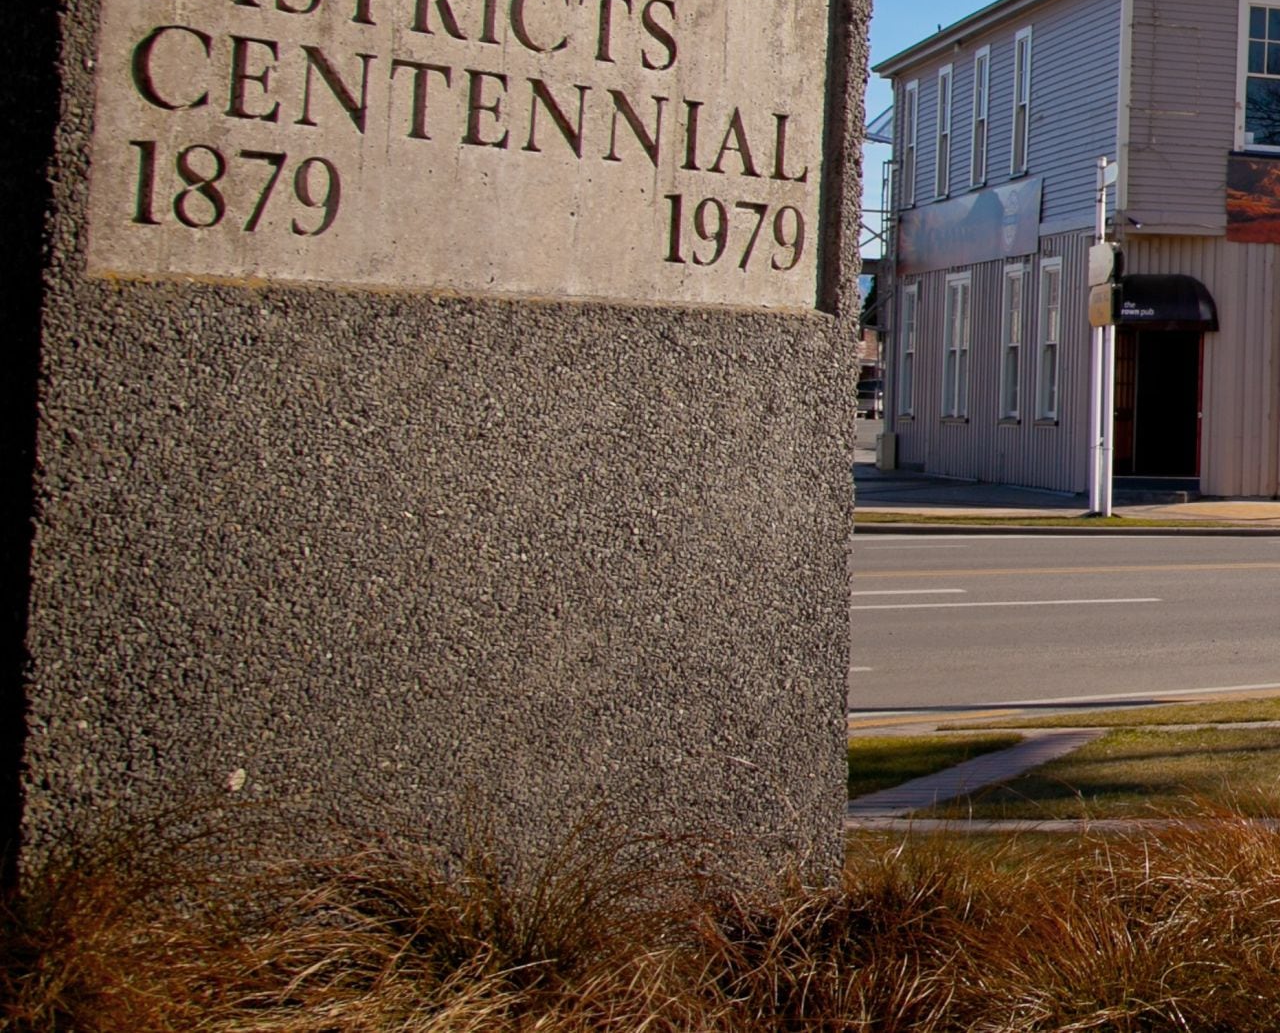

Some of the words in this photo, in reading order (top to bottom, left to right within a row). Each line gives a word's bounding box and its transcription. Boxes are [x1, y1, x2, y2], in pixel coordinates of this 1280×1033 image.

[131, 25, 809, 184] CENTENNIAL
[130, 139, 342, 236] 1879
[663, 193, 806, 272] 1979
[1124, 300, 1136, 308] the
[1140, 307, 1155, 317] pub
